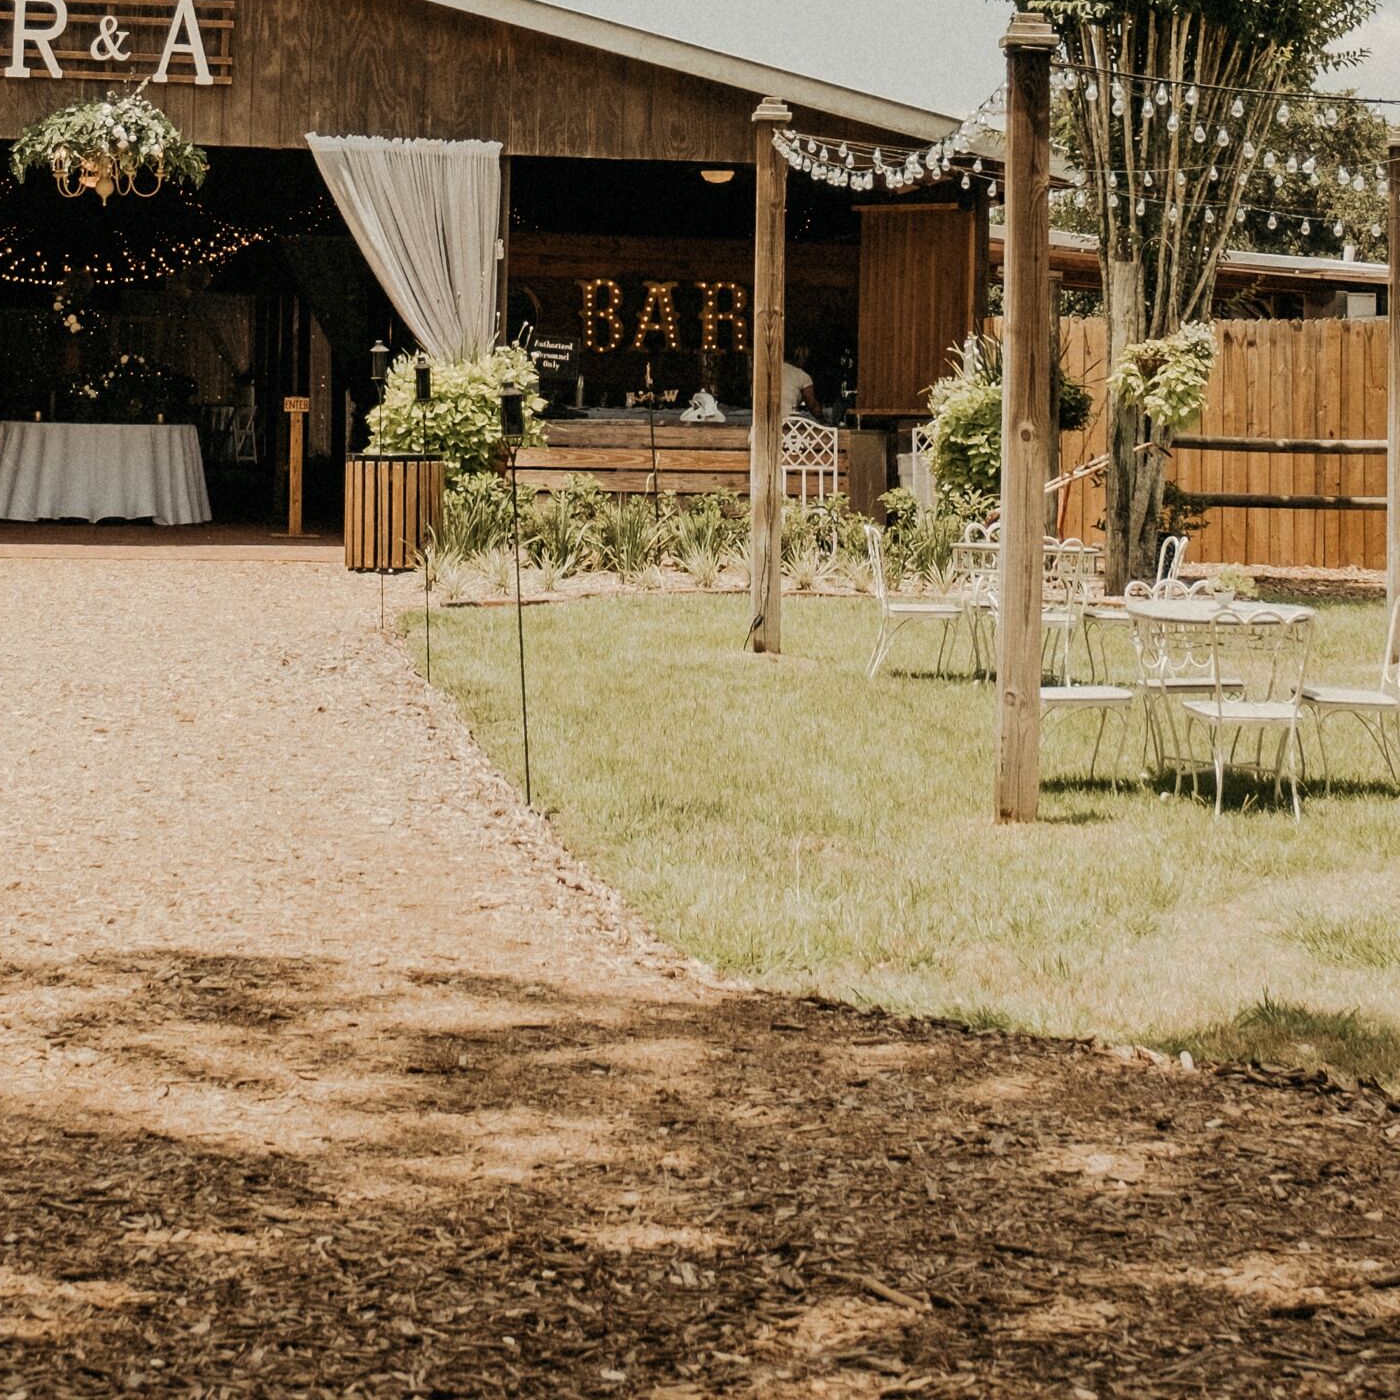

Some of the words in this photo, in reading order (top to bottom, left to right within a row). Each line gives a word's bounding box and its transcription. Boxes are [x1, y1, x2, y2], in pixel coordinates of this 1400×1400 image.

[90, 15, 131, 61] &
[576, 278, 755, 353] BAR
[534, 340, 573, 350] Authorized
[542, 360, 560, 371] Only
[285, 399, 309, 409] ENTER
